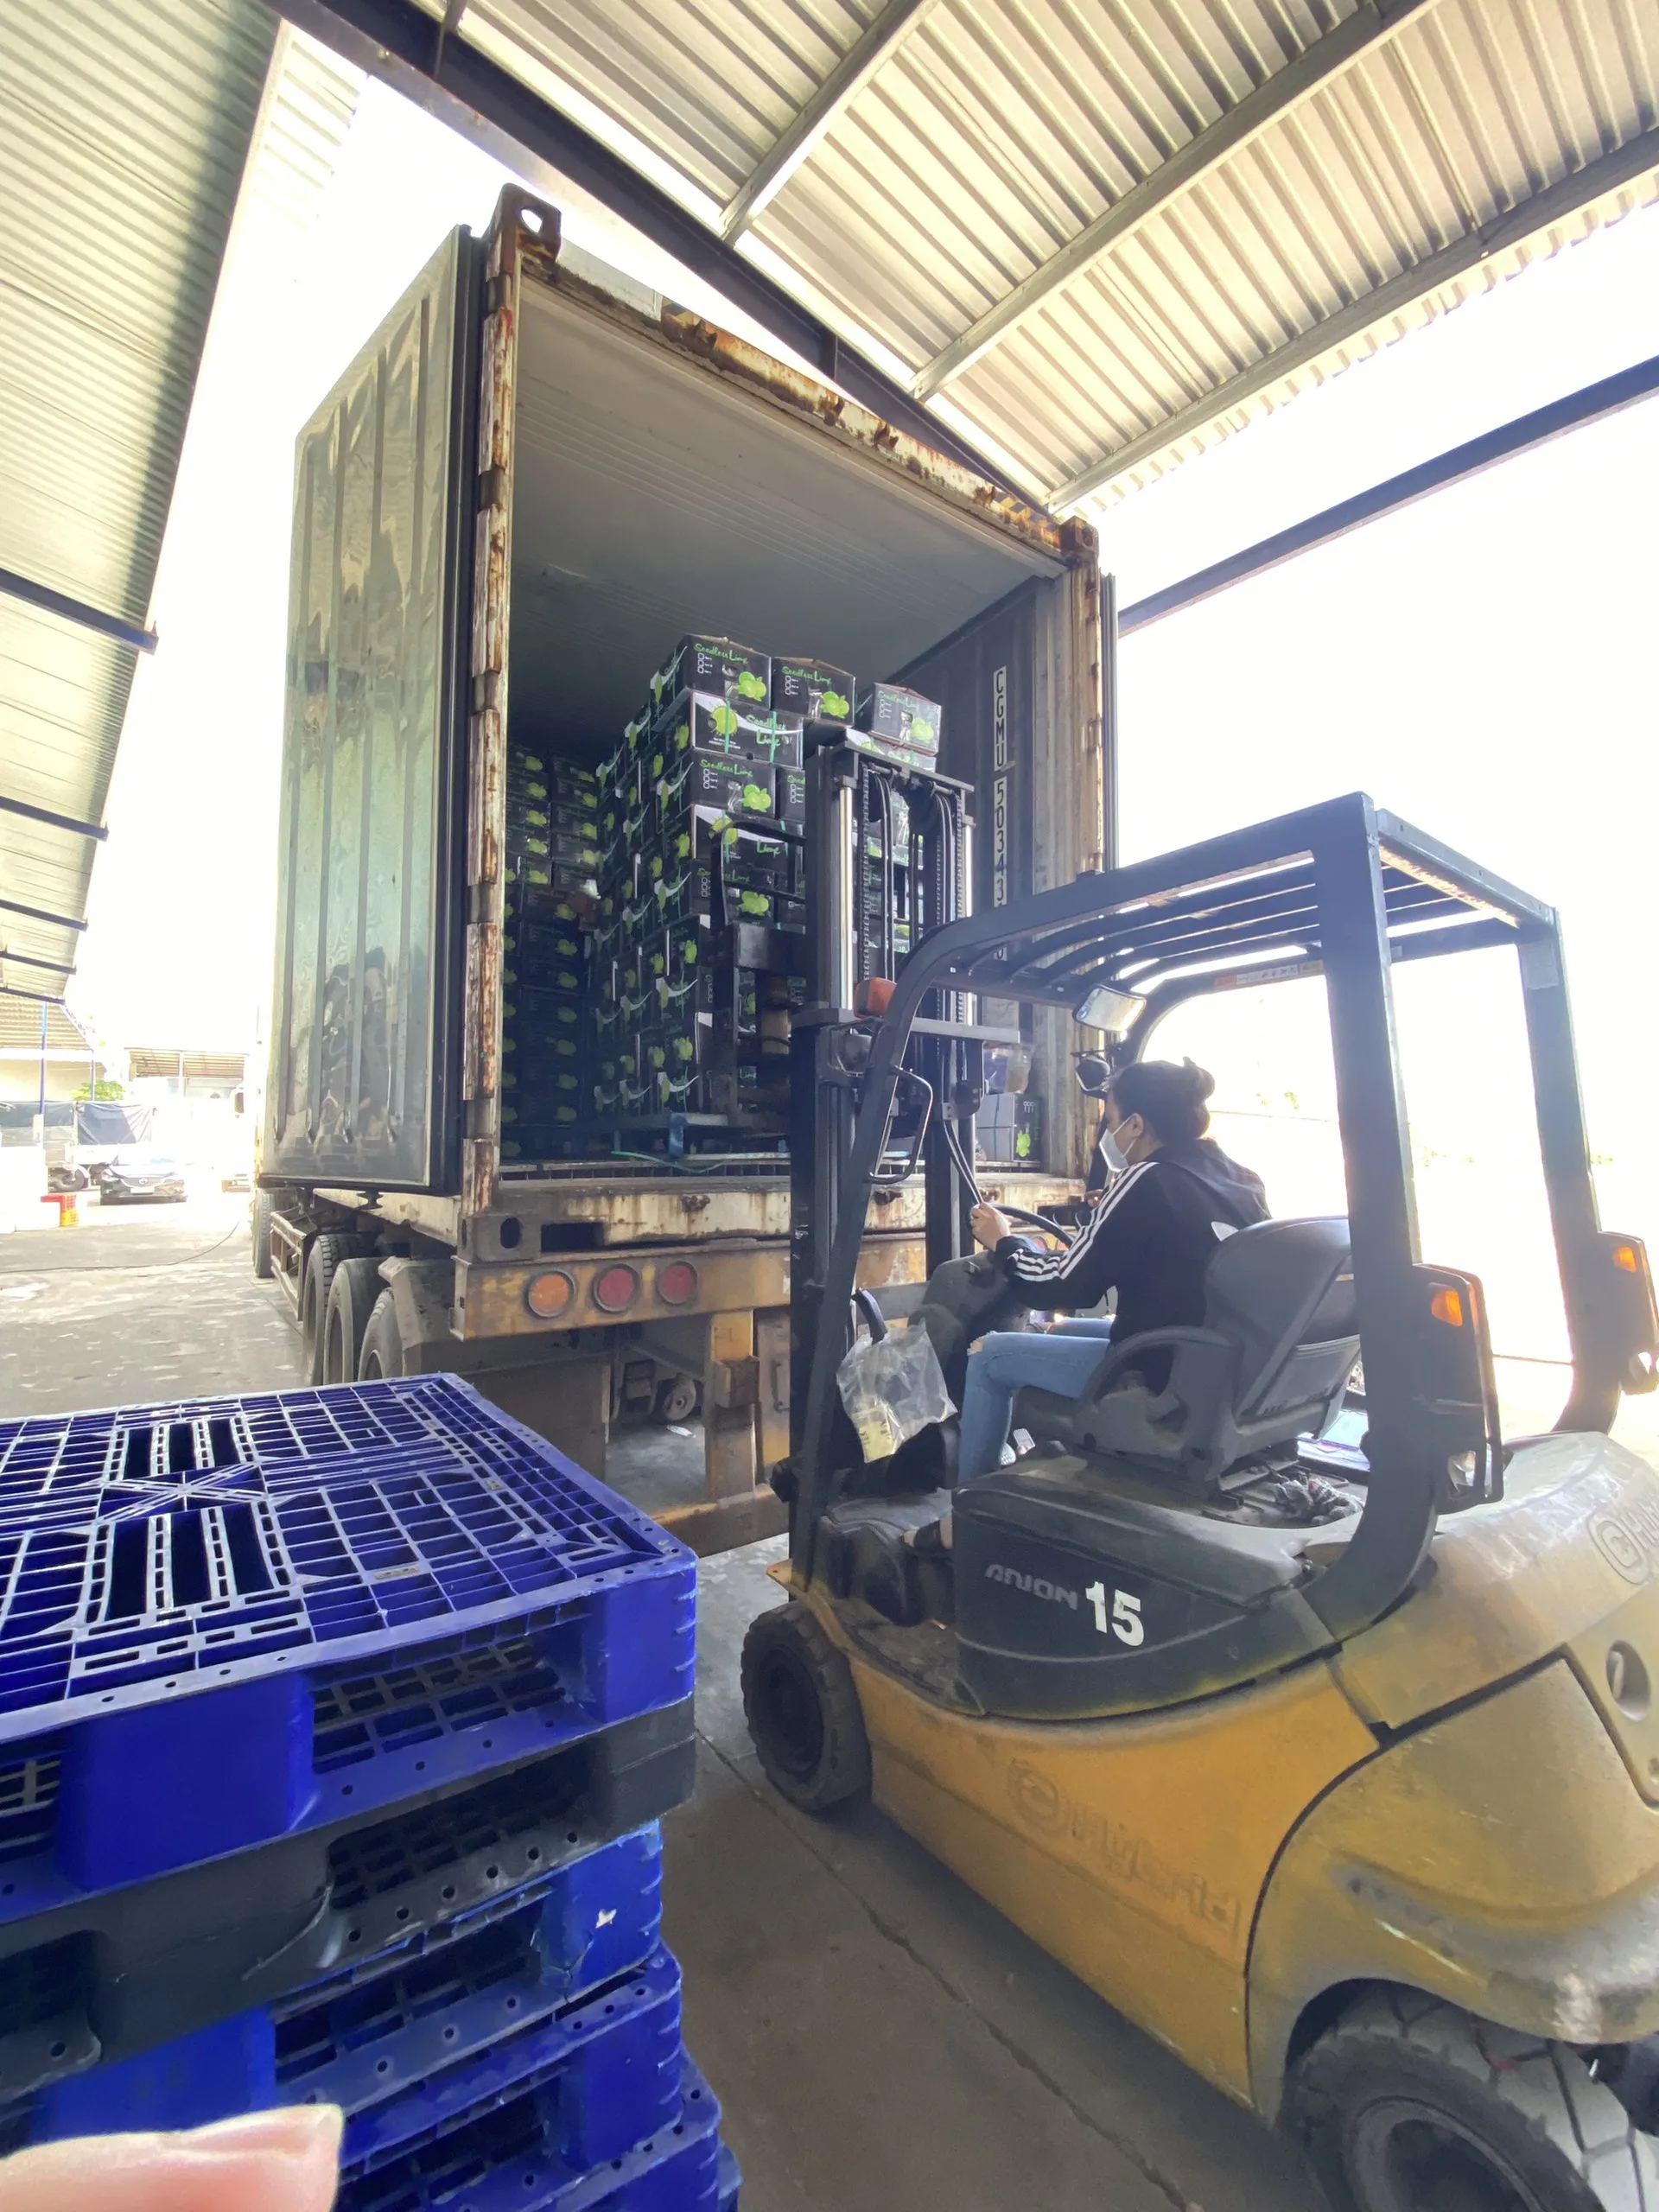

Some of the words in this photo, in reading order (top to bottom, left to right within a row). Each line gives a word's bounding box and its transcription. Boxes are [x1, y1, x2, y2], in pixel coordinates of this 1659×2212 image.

[694, 643, 728, 658] Seedless
[729, 650, 748, 664] Lime
[781, 665, 814, 680] Seedless
[700, 760, 734, 773] Seedless
[996, 780, 1005, 906] 50343
[1085, 1580, 1145, 1647] 15
